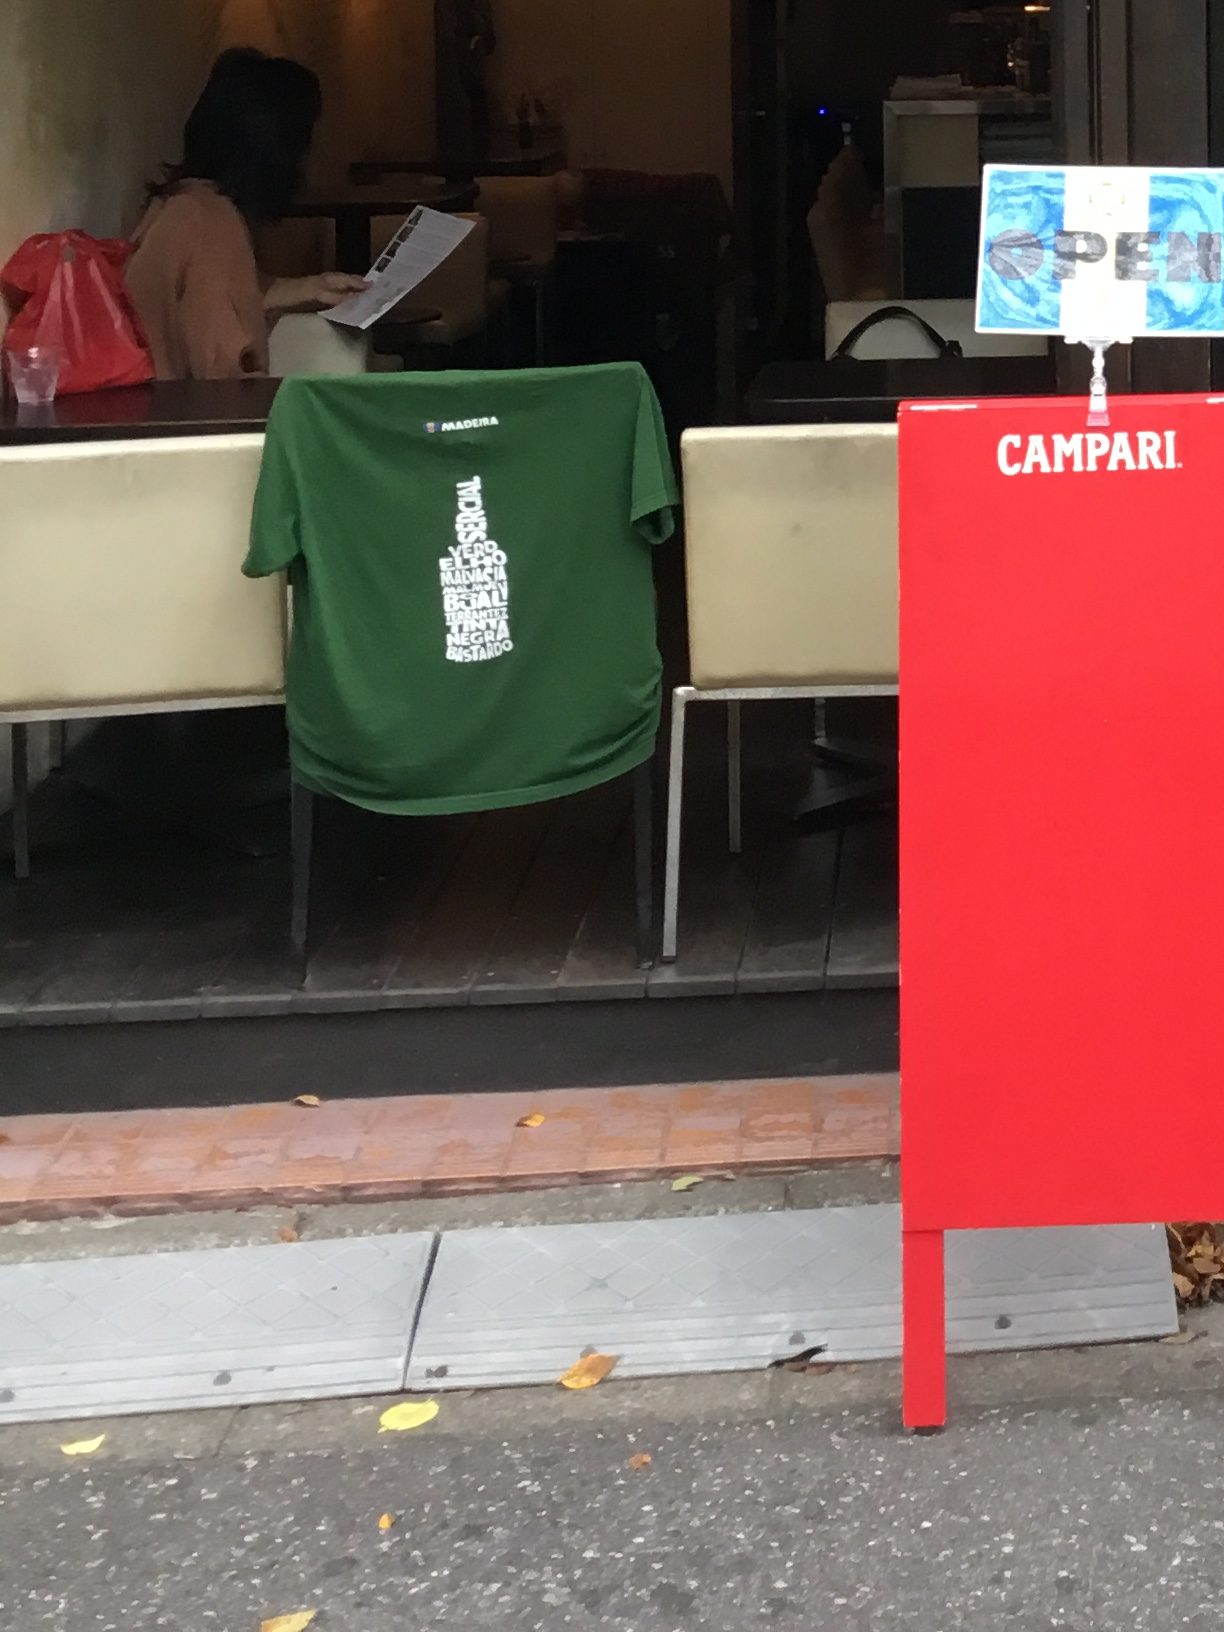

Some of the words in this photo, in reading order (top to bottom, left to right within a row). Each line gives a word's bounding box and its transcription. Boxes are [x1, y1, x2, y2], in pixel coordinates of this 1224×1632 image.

[988, 229, 1222, 283] OPEN
[441, 416, 499, 432] MADEIRA
[997, 430, 1178, 476] CAMPARI
[455, 475, 487, 543] SERCIAL
[440, 566, 507, 587] MALVASIA
[446, 640, 513, 662] BASTARDO
